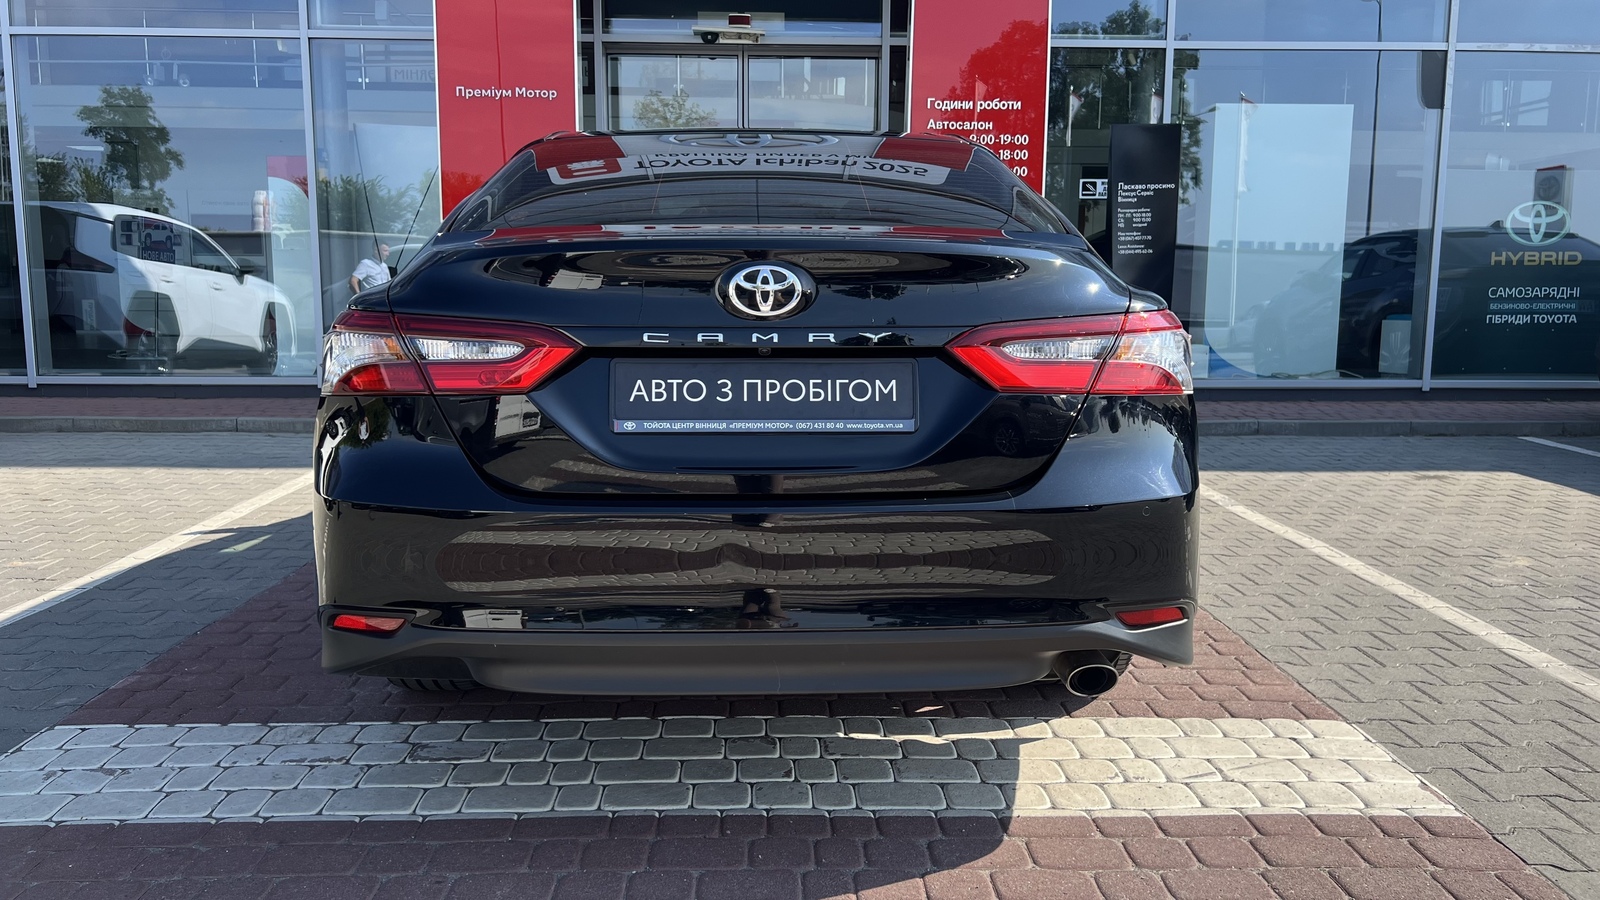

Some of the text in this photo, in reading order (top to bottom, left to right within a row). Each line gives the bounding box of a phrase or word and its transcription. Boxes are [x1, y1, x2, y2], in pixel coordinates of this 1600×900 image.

[455, 85, 558, 101] Преміум Мотор
[927, 98, 1022, 112] Години роботи
[927, 119, 993, 130] Автосалон
[1490, 251, 1582, 266] HYBRID
[1487, 286, 1580, 300] САМОЗАРЯДНІ
[1489, 302, 1576, 310] БЕНЗИНОВО-ЕЛЕКТРИЧНІ
[1486, 314, 1577, 325] ГІБРИДИ TOYOTA
[642, 331, 892, 344] CAMRY
[629, 378, 898, 405] АВТО З ПРОБІГОМ
[643, 421, 904, 431] ТОЙОТА ЦЕНТР ВІННИЦЯ «ПРЕМІУМ МОТОР» (067) 431 80 40 www.toyota.vn.ua
